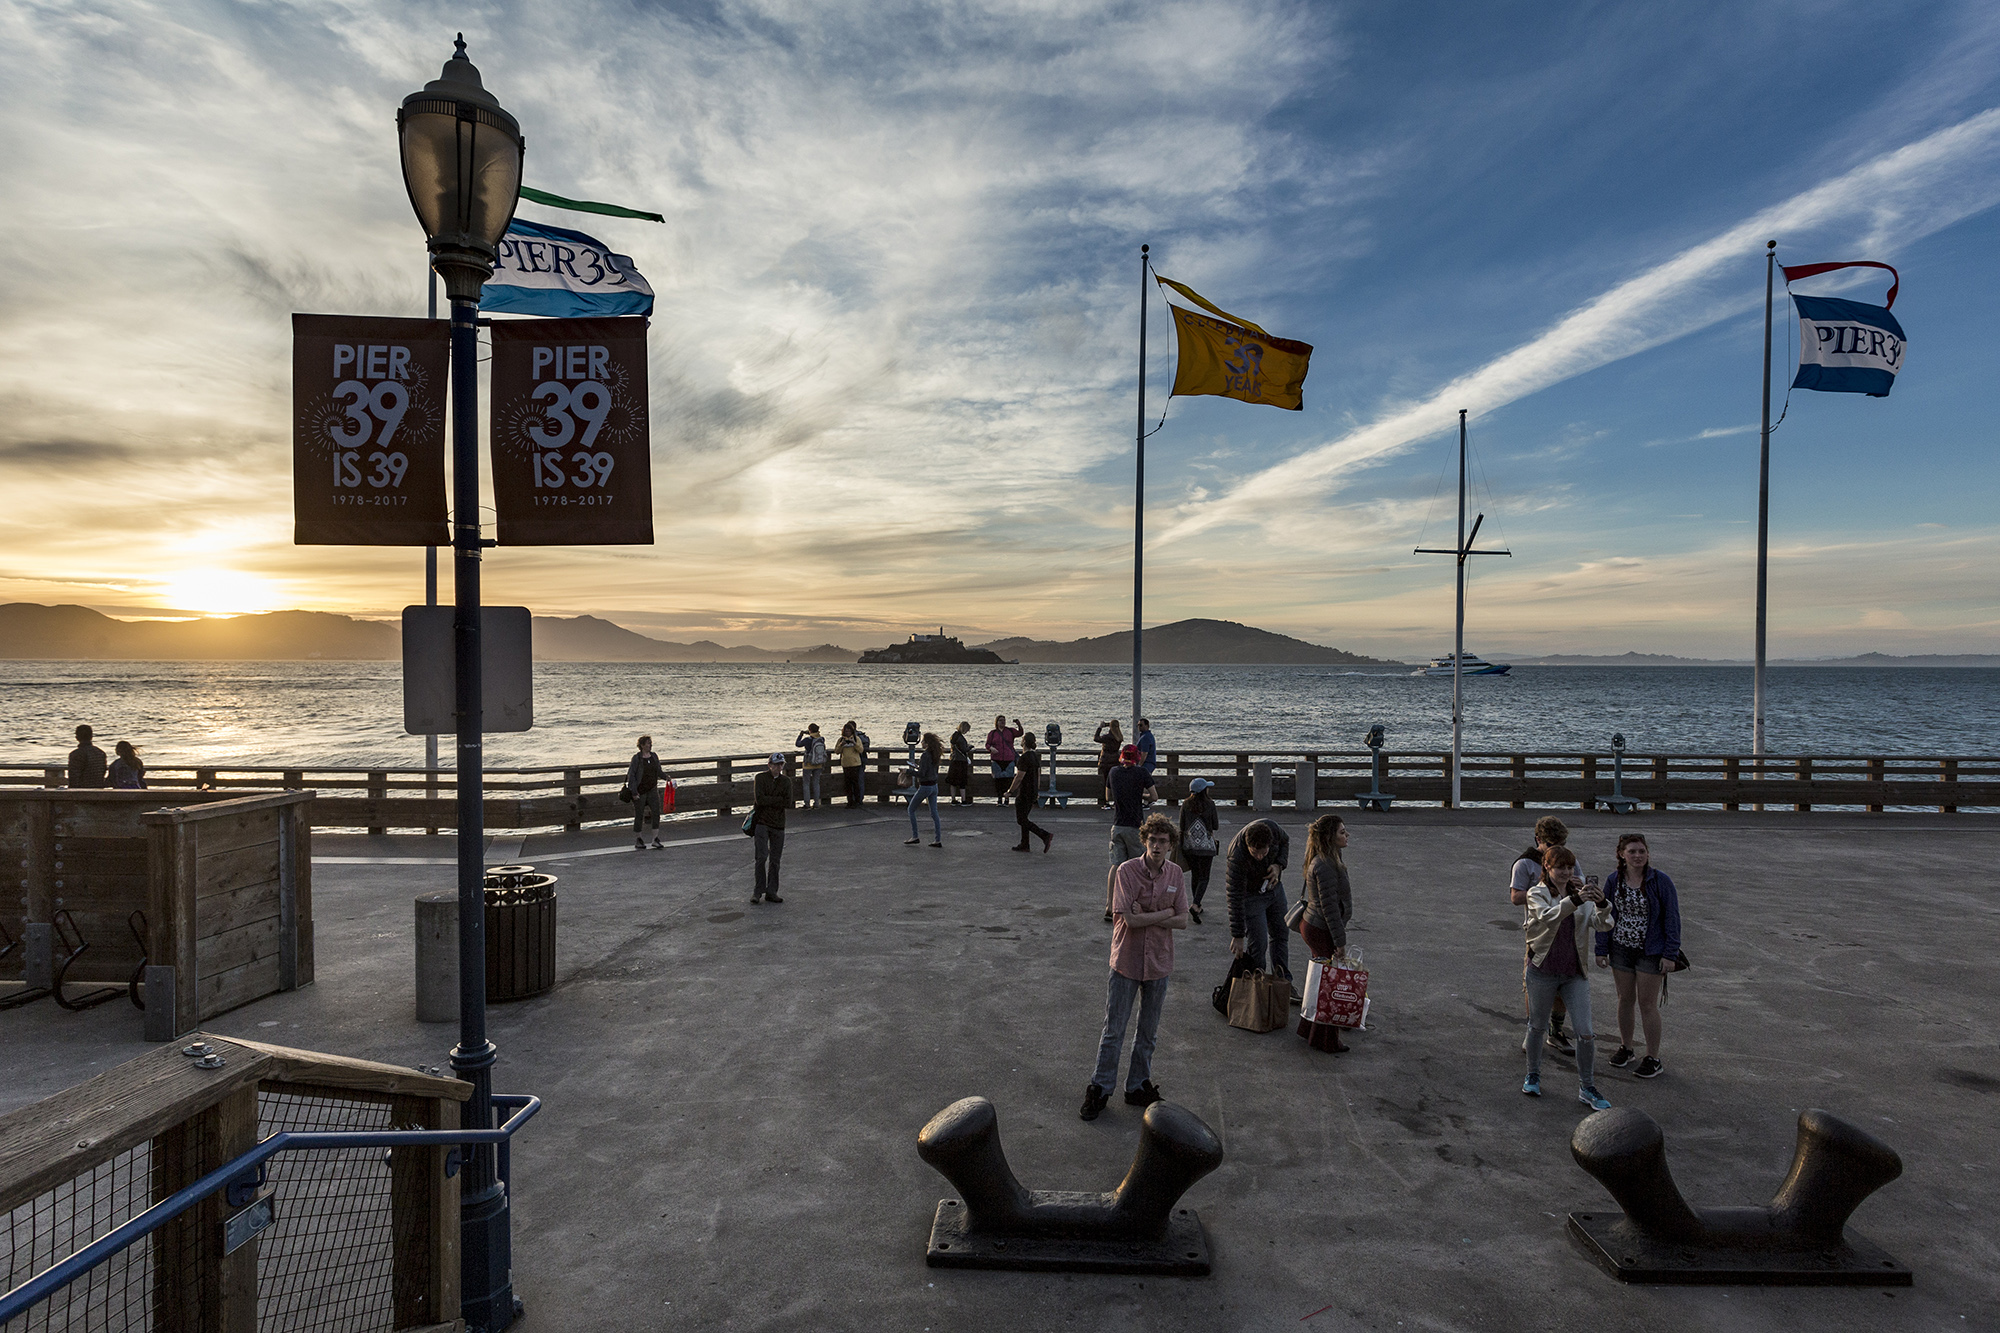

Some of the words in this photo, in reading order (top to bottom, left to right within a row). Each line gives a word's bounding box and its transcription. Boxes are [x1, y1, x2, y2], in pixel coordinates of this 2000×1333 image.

[494, 238, 581, 278] PIER
[1224, 336, 1263, 377] 39
[1815, 325, 1888, 358] PIER
[333, 344, 411, 380] PIER
[532, 345, 612, 380] PIER
[330, 380, 410, 448] 39
[529, 380, 612, 448] 39
[333, 451, 362, 488] IS
[367, 451, 409, 488] 39
[533, 451, 566, 488] IS
[571, 451, 615, 488] 39
